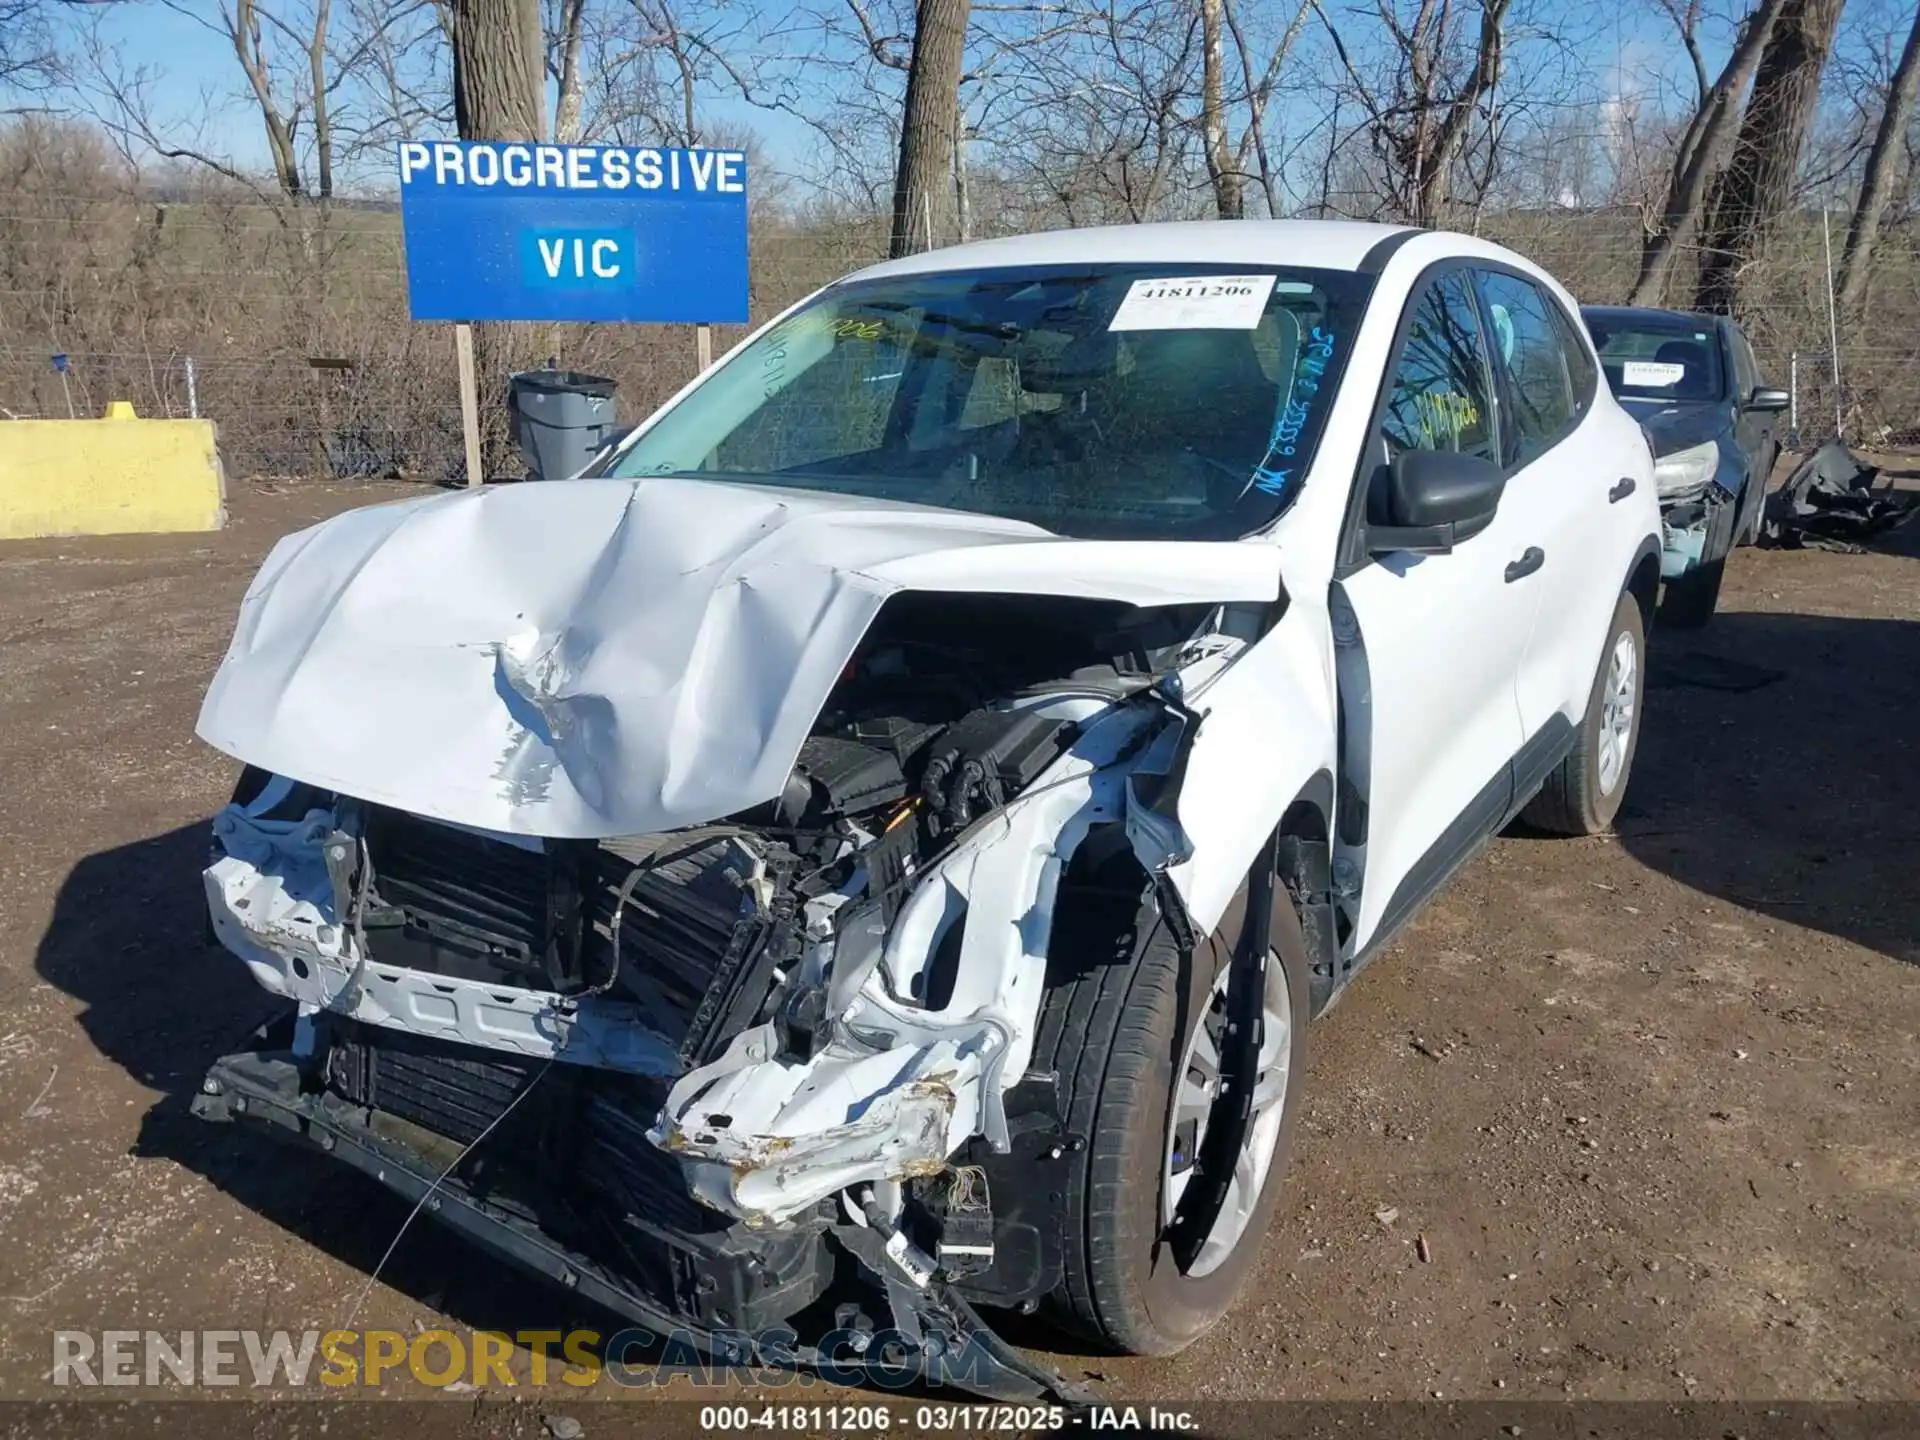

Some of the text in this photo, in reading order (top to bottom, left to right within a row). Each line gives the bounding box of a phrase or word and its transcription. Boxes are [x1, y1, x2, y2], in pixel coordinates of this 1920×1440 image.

[401, 144, 744, 192] PROGRESSIVE
[538, 238, 620, 278] VIC
[1142, 286, 1253, 298] 41811206
